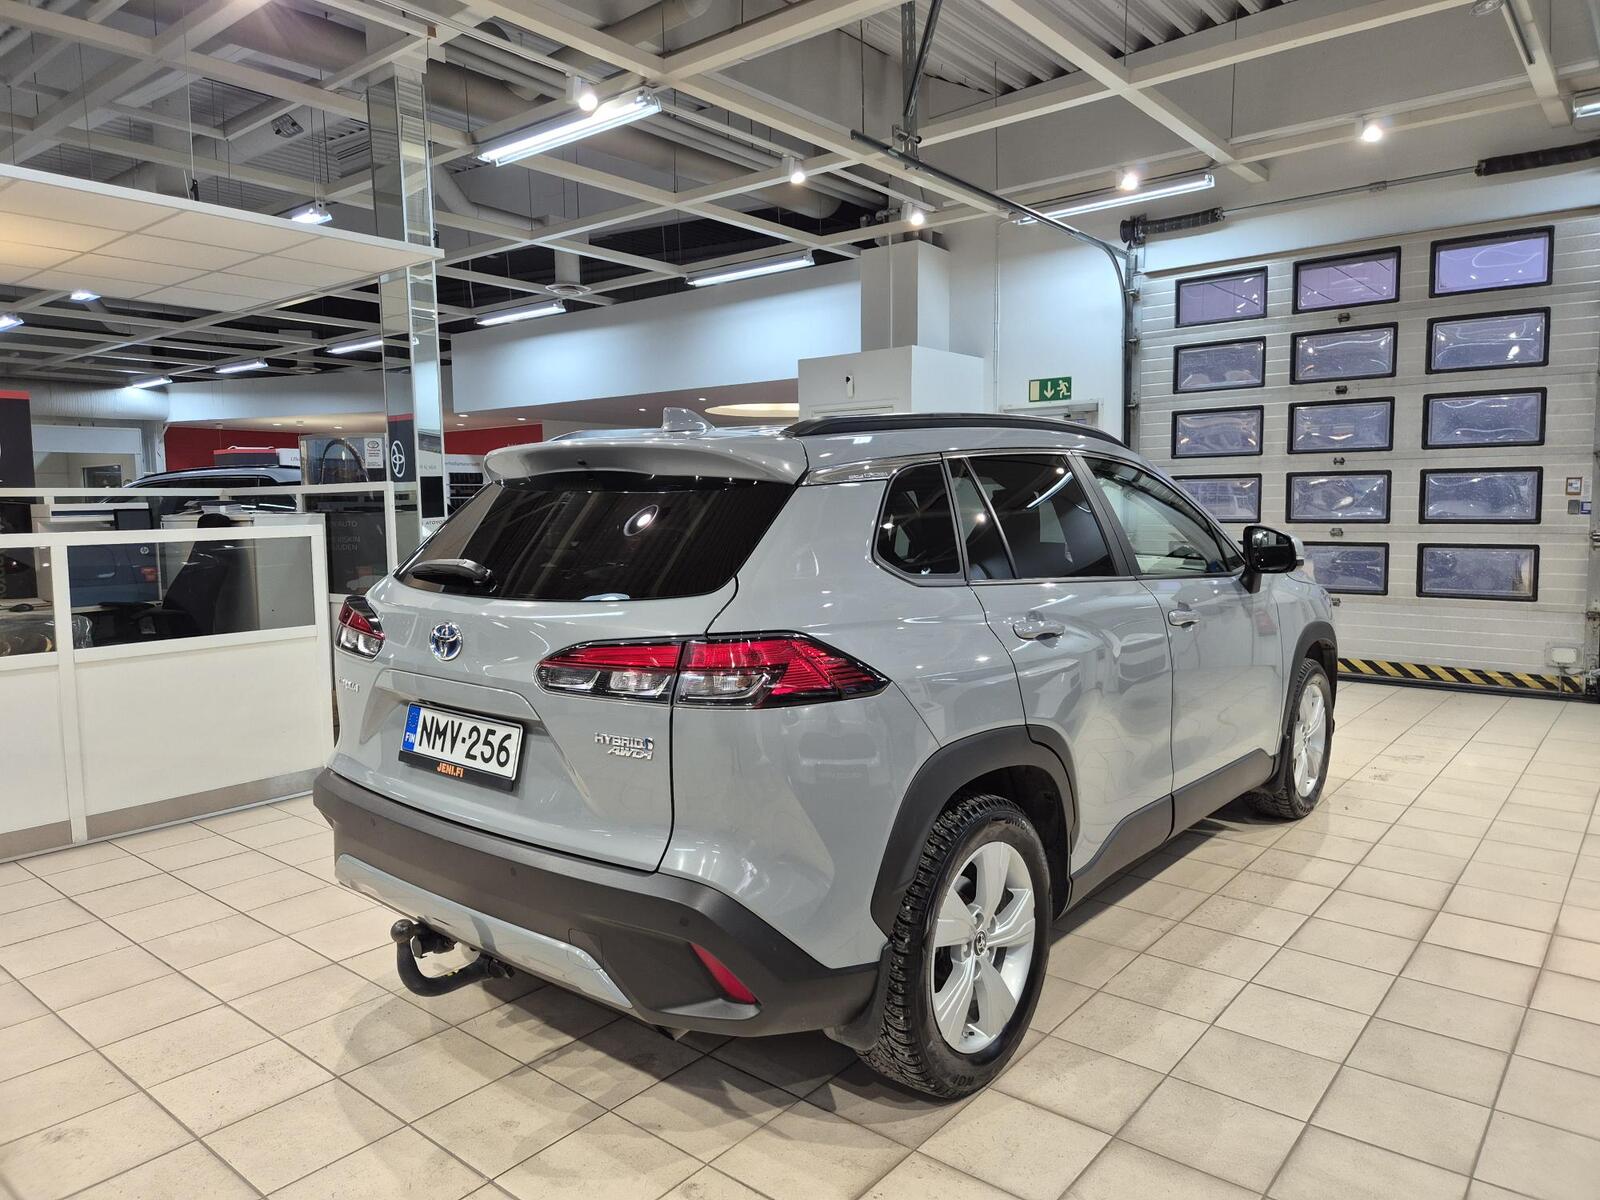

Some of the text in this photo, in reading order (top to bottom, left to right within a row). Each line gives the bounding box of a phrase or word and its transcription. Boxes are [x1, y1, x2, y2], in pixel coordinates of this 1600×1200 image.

[405, 732, 416, 744] FIN
[418, 714, 512, 768] NMV-256
[594, 732, 644, 749] HYBRID
[436, 762, 464, 778] JENI.FI
